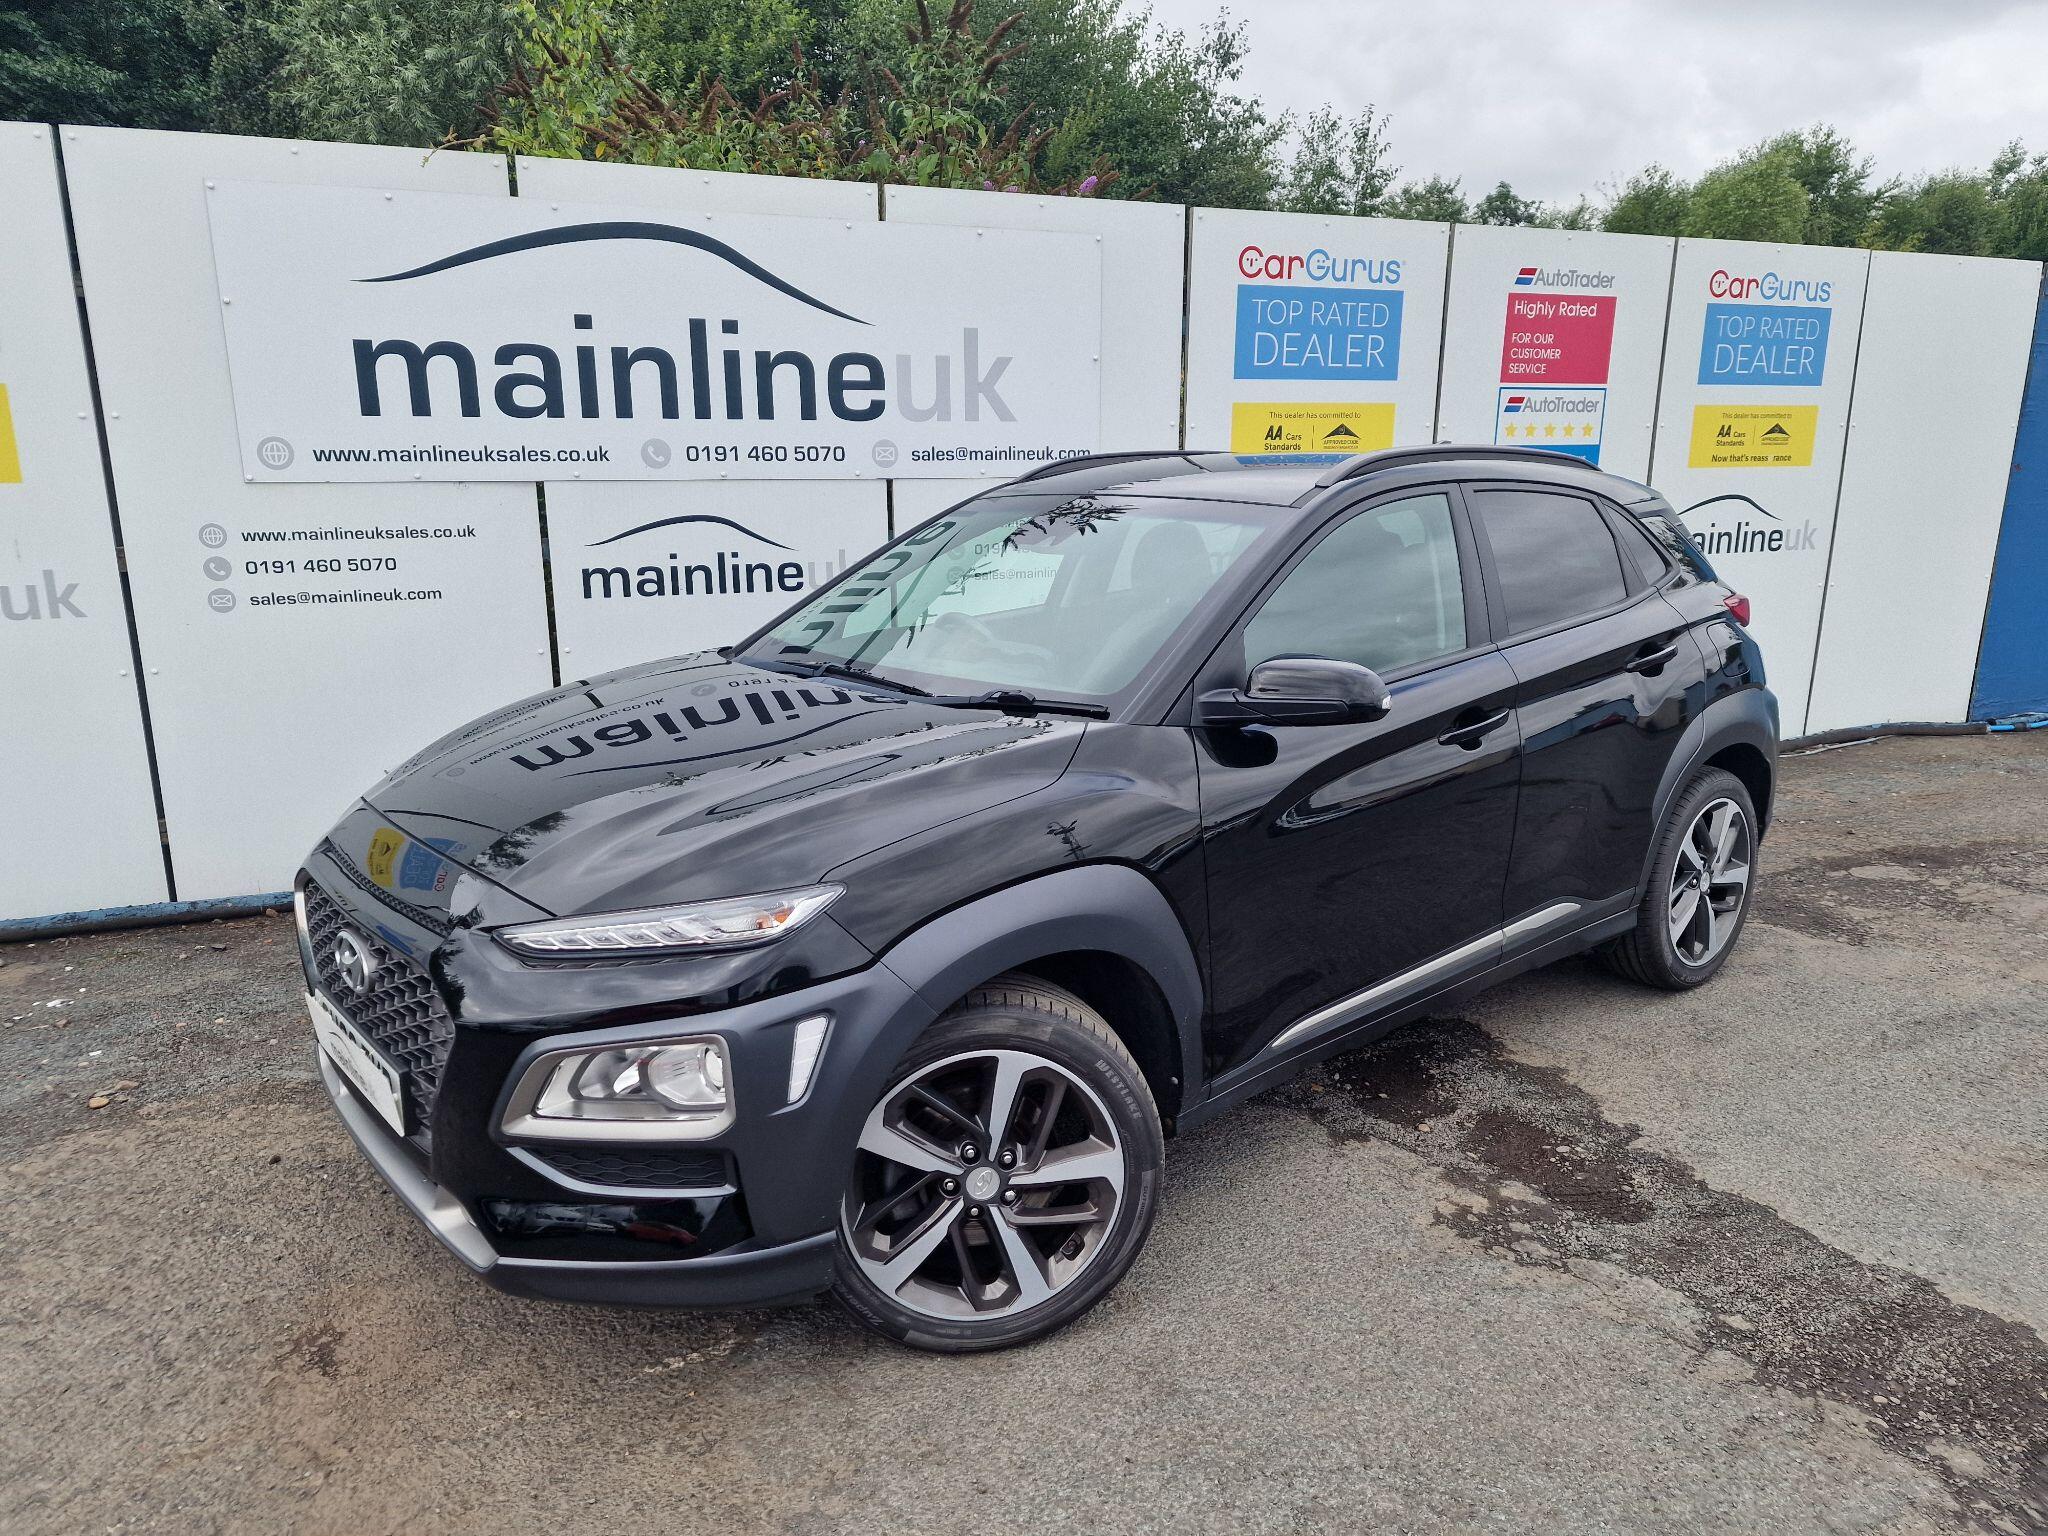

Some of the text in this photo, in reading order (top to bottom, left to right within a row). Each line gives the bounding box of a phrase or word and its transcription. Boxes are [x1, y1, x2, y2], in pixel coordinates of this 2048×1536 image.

[1238, 245, 1401, 285] CarGurus
[1534, 268, 1615, 289] AutoTrader
[1709, 269, 1832, 303] CarGurus
[1252, 299, 1389, 328] TOP RATED
[1514, 300, 1597, 319] Highly Rated
[1716, 315, 1820, 340] TOP RATED
[1512, 333, 1555, 345] FOR OUR
[1253, 331, 1385, 368] DEALER
[1510, 348, 1561, 360] CUSTOMER
[352, 314, 1018, 422] mainlineuk
[1713, 343, 1815, 375] DEALER
[1508, 363, 1547, 374] SERVICE
[1522, 397, 1599, 413] AutoTrader
[1264, 425, 1302, 441] AA Cars
[1717, 424, 1732, 438] AA
[312, 443, 611, 463] www.mainlineuksales.co.uk
[685, 446, 846, 463] 0191 460 5070
[911, 446, 1091, 461] sales@mainlineuk.com
[1264, 443, 1302, 451] Standards
[1711, 453, 1792, 463] Now that's reassrance
[241, 525, 477, 542] www.mainlineuksales.co.uk
[1692, 519, 1817, 554] ainlineuk
[245, 557, 398, 575] 0191 460 5070
[250, 588, 443, 606] sales@mainlineuk.com
